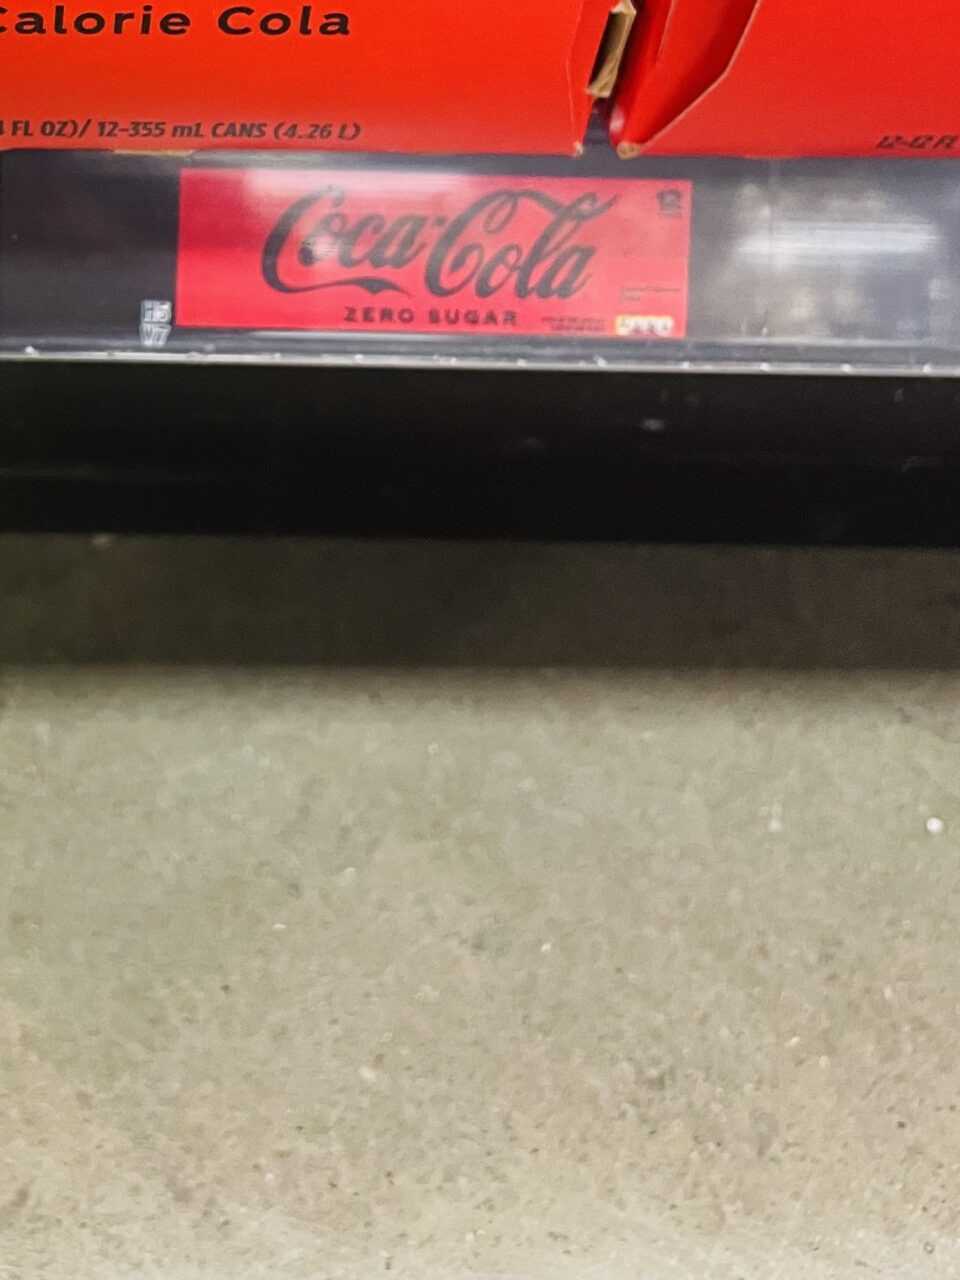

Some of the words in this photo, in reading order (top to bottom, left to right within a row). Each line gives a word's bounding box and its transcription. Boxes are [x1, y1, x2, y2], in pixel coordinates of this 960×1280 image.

[218, 4, 352, 37] Cola
[12, 120, 35, 137] FL
[97, 121, 166, 138] 12-355
[211, 122, 268, 139] CANS
[261, 183, 620, 300] Coca-Cola
[343, 305, 416, 324] ZERO
[427, 307, 518, 327] SUGAR
